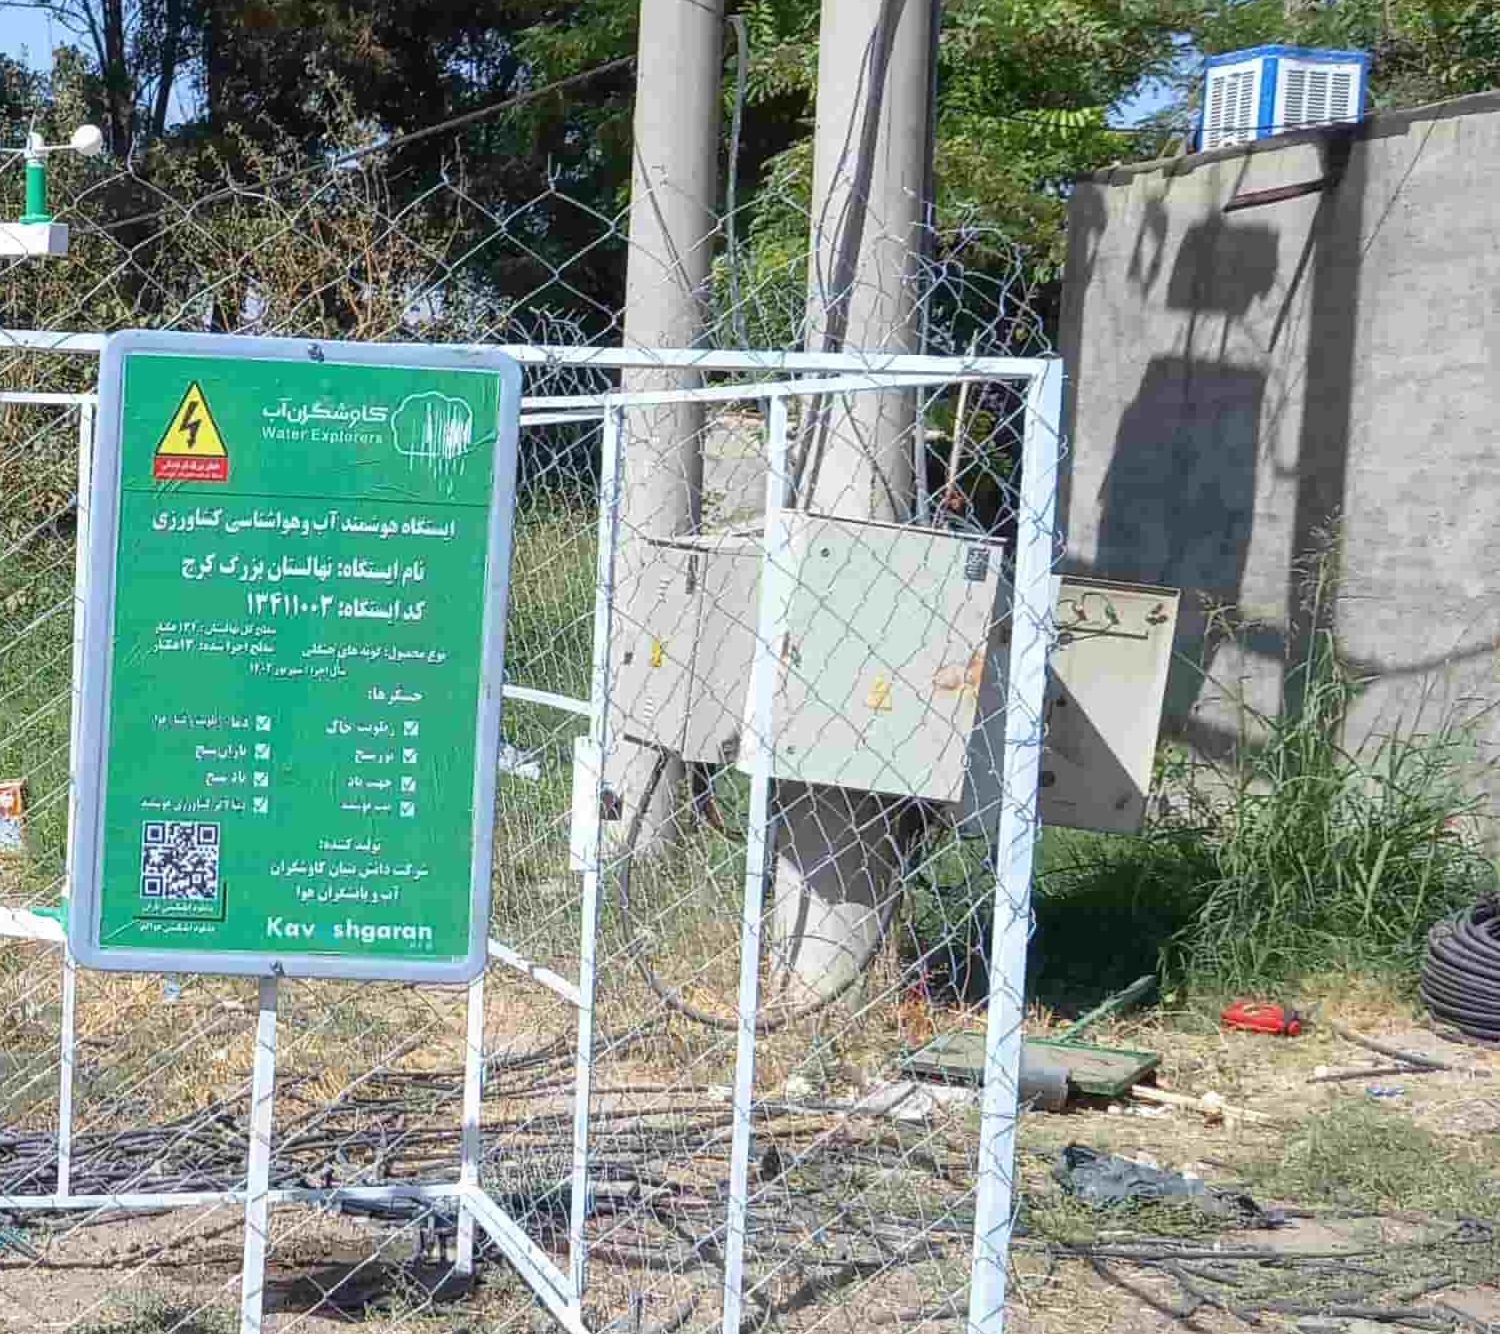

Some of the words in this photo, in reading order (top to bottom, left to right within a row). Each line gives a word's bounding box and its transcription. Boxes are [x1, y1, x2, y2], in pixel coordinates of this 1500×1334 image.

[261, 397, 288, 424] آب
[261, 427, 307, 443] Water
[310, 428, 383, 445] Explorers
[152, 507, 223, 533] کشاورزی
[312, 508, 340, 535] آب
[341, 515, 399, 539] هوشمند
[401, 516, 456, 541] ایستگاه
[181, 552, 217, 580] کرج
[267, 554, 334, 582] نهالستان
[337, 556, 400, 585] ایستگاه:
[402, 559, 426, 587] نام
[339, 595, 401, 623] ایستگاه:
[403, 601, 427, 621] کد
[270, 860, 327, 879] کاوشگران
[359, 861, 391, 879] دانش
[393, 862, 429, 881] شرکت
